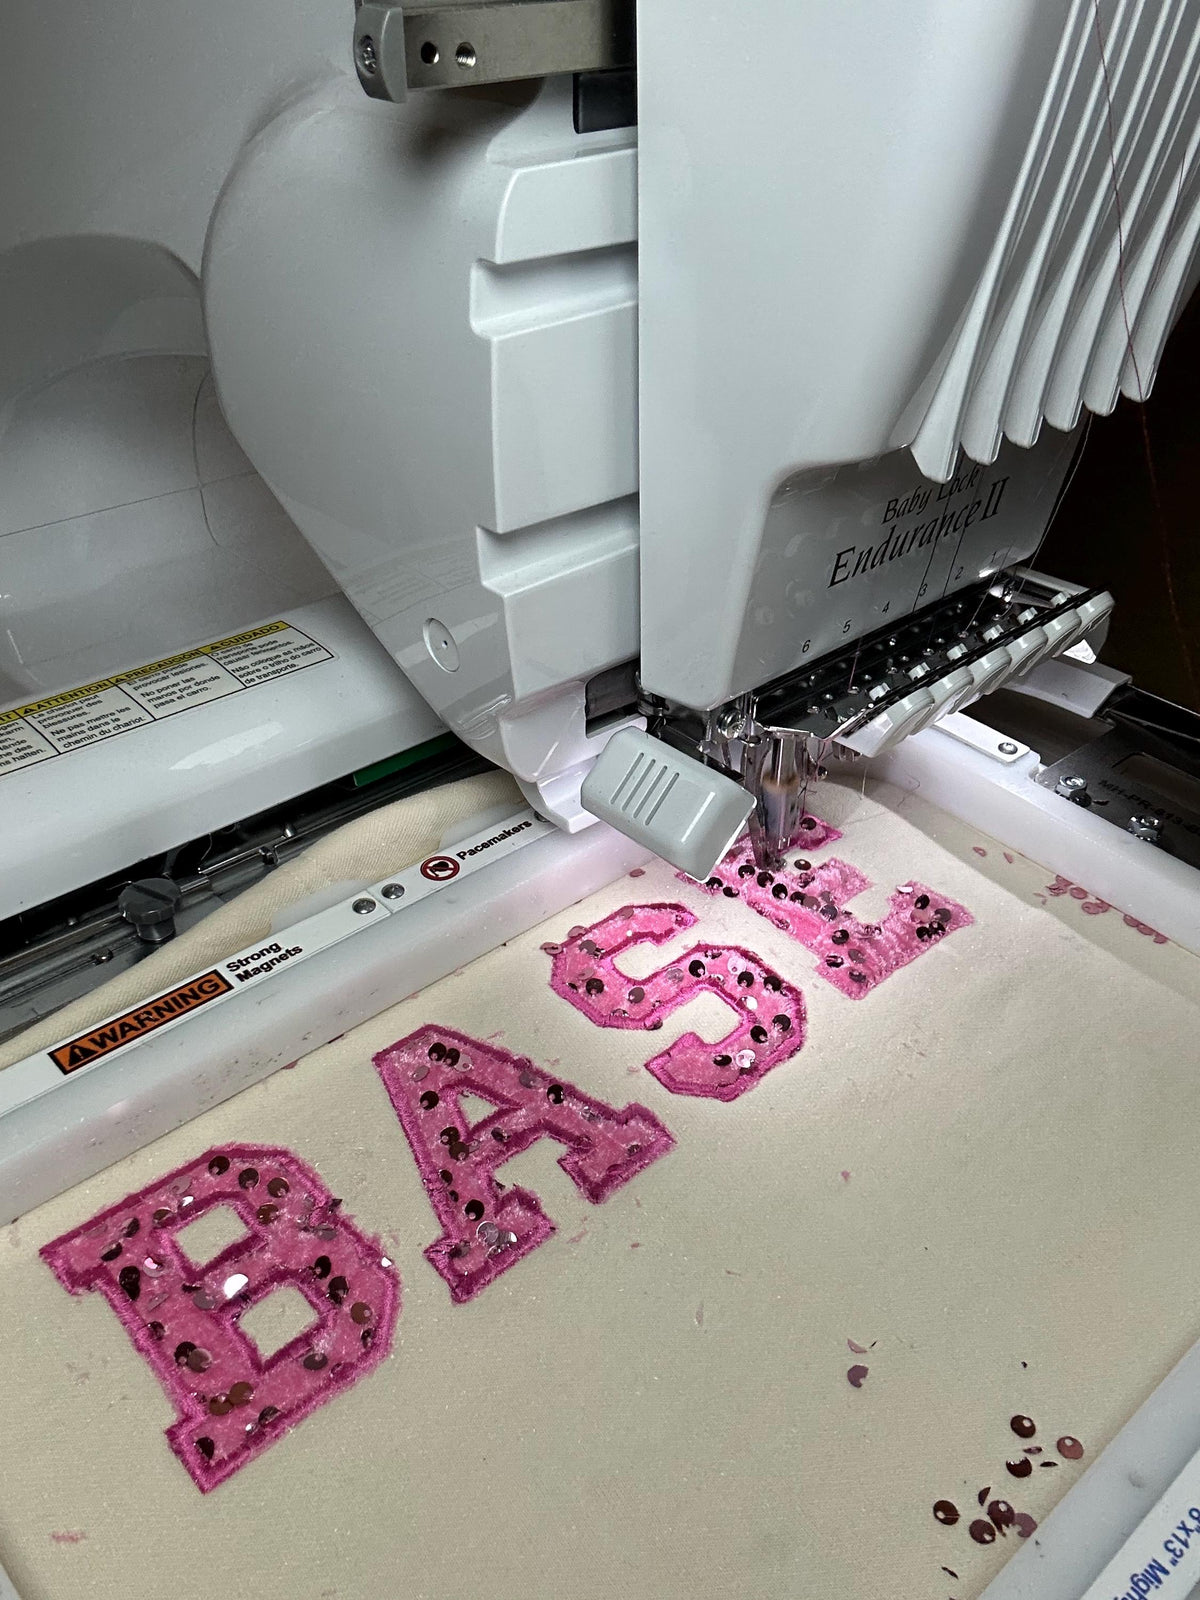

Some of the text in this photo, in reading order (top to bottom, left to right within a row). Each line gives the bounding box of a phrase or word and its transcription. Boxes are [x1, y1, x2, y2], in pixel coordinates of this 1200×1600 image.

[881, 463, 980, 524] Baby Lock
[828, 476, 1010, 588] Endurance II
[801, 639, 811, 653] 6
[842, 619, 852, 633] 5
[881, 600, 890, 614] 4
[918, 583, 928, 597] 3
[954, 566, 963, 580] 2
[219, 624, 280, 647] CUIDADO
[216, 639, 279, 661] transporte pode
[223, 654, 250, 666] causar
[230, 664, 250, 674] Não
[250, 653, 282, 668] coloque
[293, 641, 315, 652] mãos
[238, 667, 261, 679] sobre
[289, 653, 301, 661] do
[300, 646, 322, 659] carro
[126, 650, 200, 679] PRECAUCIÓN
[133, 662, 209, 691] provocar lesiones.
[161, 662, 188, 674] puede
[244, 662, 300, 685] de transporte.
[36, 682, 110, 709] ATTENTION
[140, 676, 196, 698] No poner las
[147, 674, 221, 703] manos por donde
[153, 698, 176, 709] pasa
[186, 686, 212, 697] carro.
[38, 699, 103, 724] provoquer des
[46, 701, 77, 715] chariot
[79, 694, 100, 703] peut
[0, 721, 19, 731] gen
[42, 711, 91, 729] blessures.
[50, 705, 131, 737] Ne pas mettre les
[57, 729, 86, 742] mains
[87, 720, 111, 732] dans
[63, 715, 147, 749] chemin du chariot.
[12, 748, 46, 762] halten.
[14, 744, 33, 754] des
[455, 820, 533, 860] Pacemakers
[226, 942, 283, 972] Strong
[234, 945, 303, 982] Magnets
[87, 978, 221, 1050] WARNING
